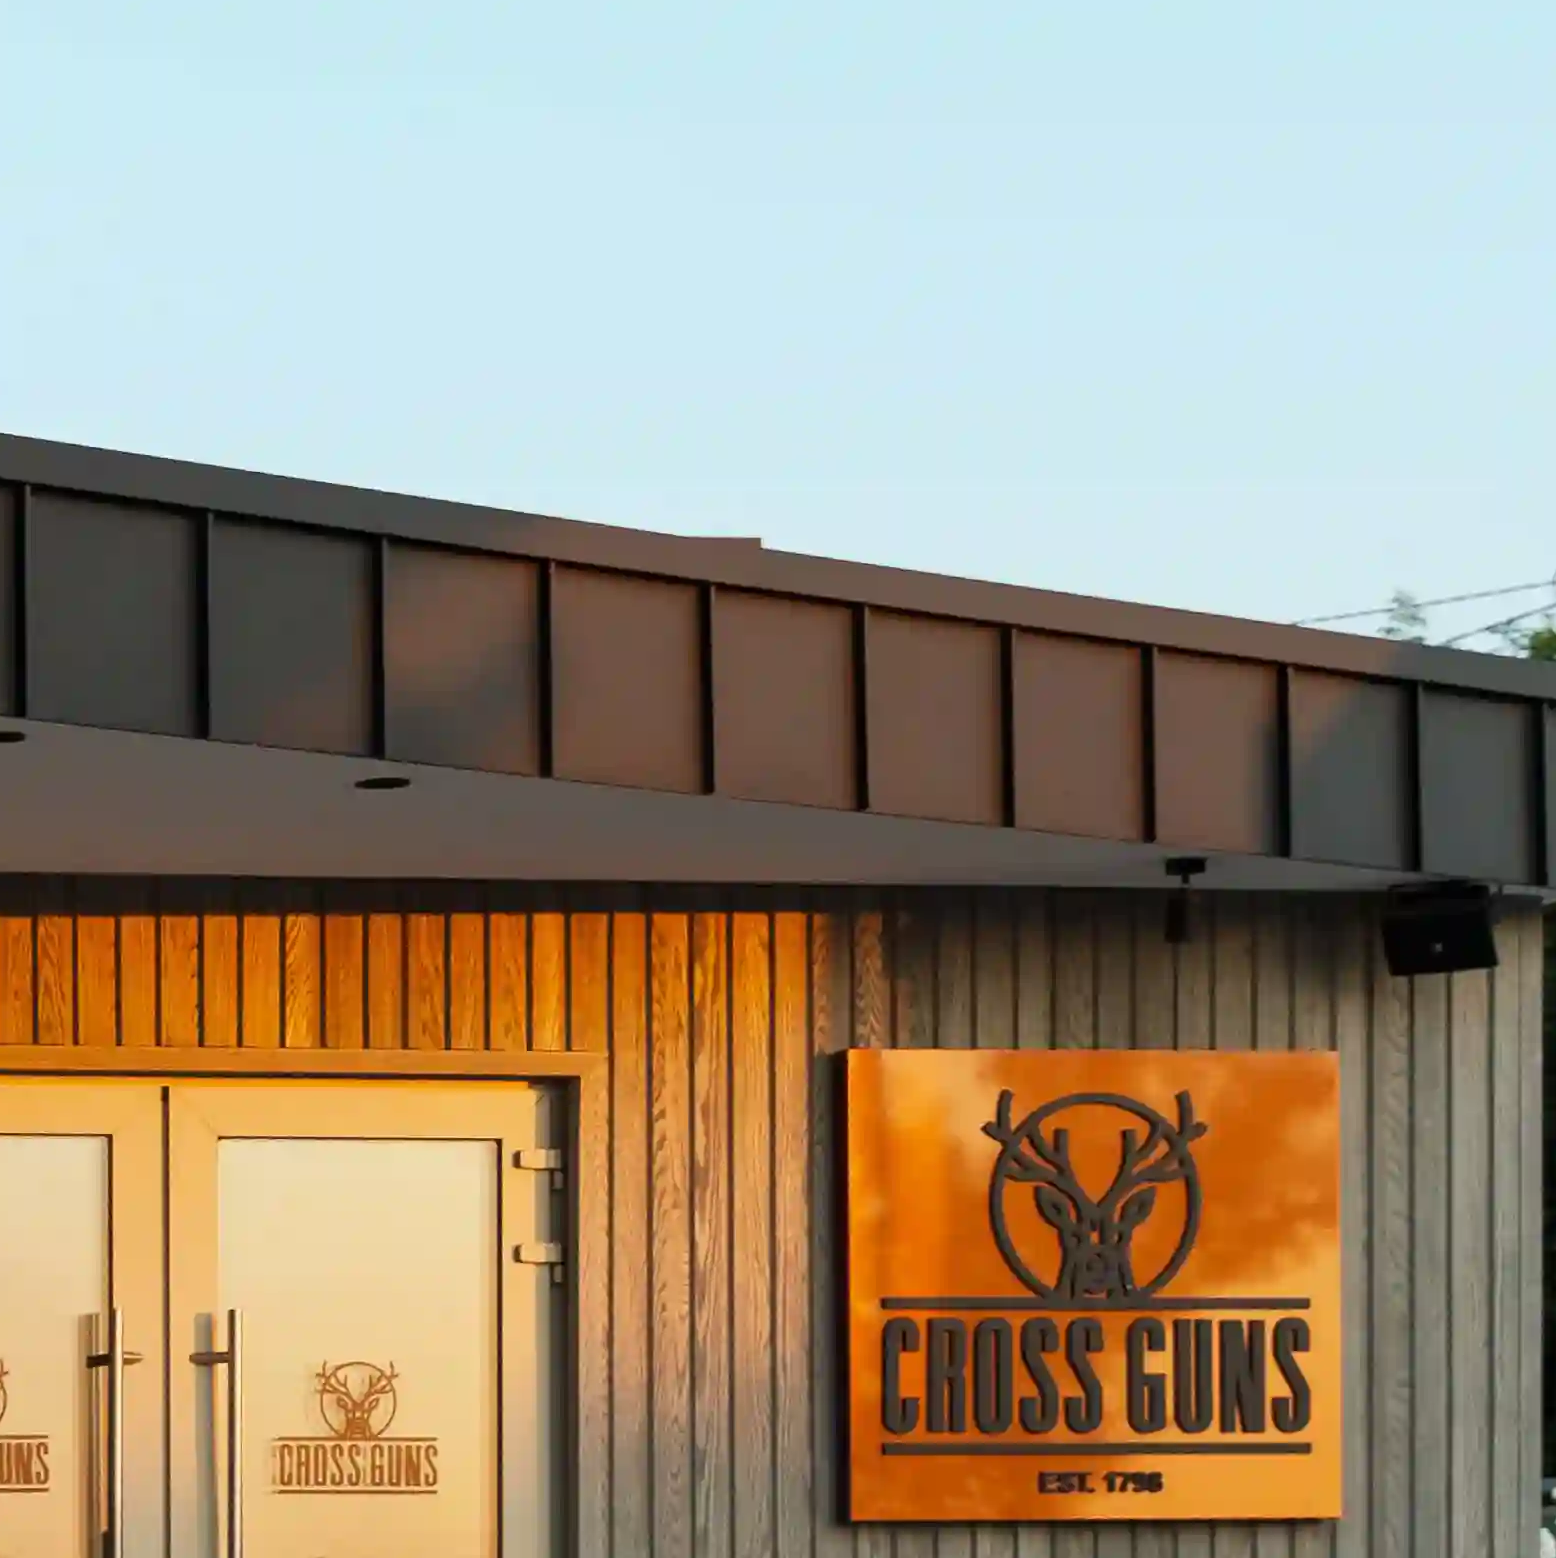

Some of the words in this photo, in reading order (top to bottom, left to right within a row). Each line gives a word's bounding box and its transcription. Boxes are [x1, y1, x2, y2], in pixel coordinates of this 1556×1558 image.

[881, 1317, 1104, 1435] CROSS
[1125, 1317, 1312, 1434] GUNS
[278, 1443, 362, 1486] CROSS
[370, 1443, 438, 1487] GUNS
[1037, 1471, 1096, 1494] EST.
